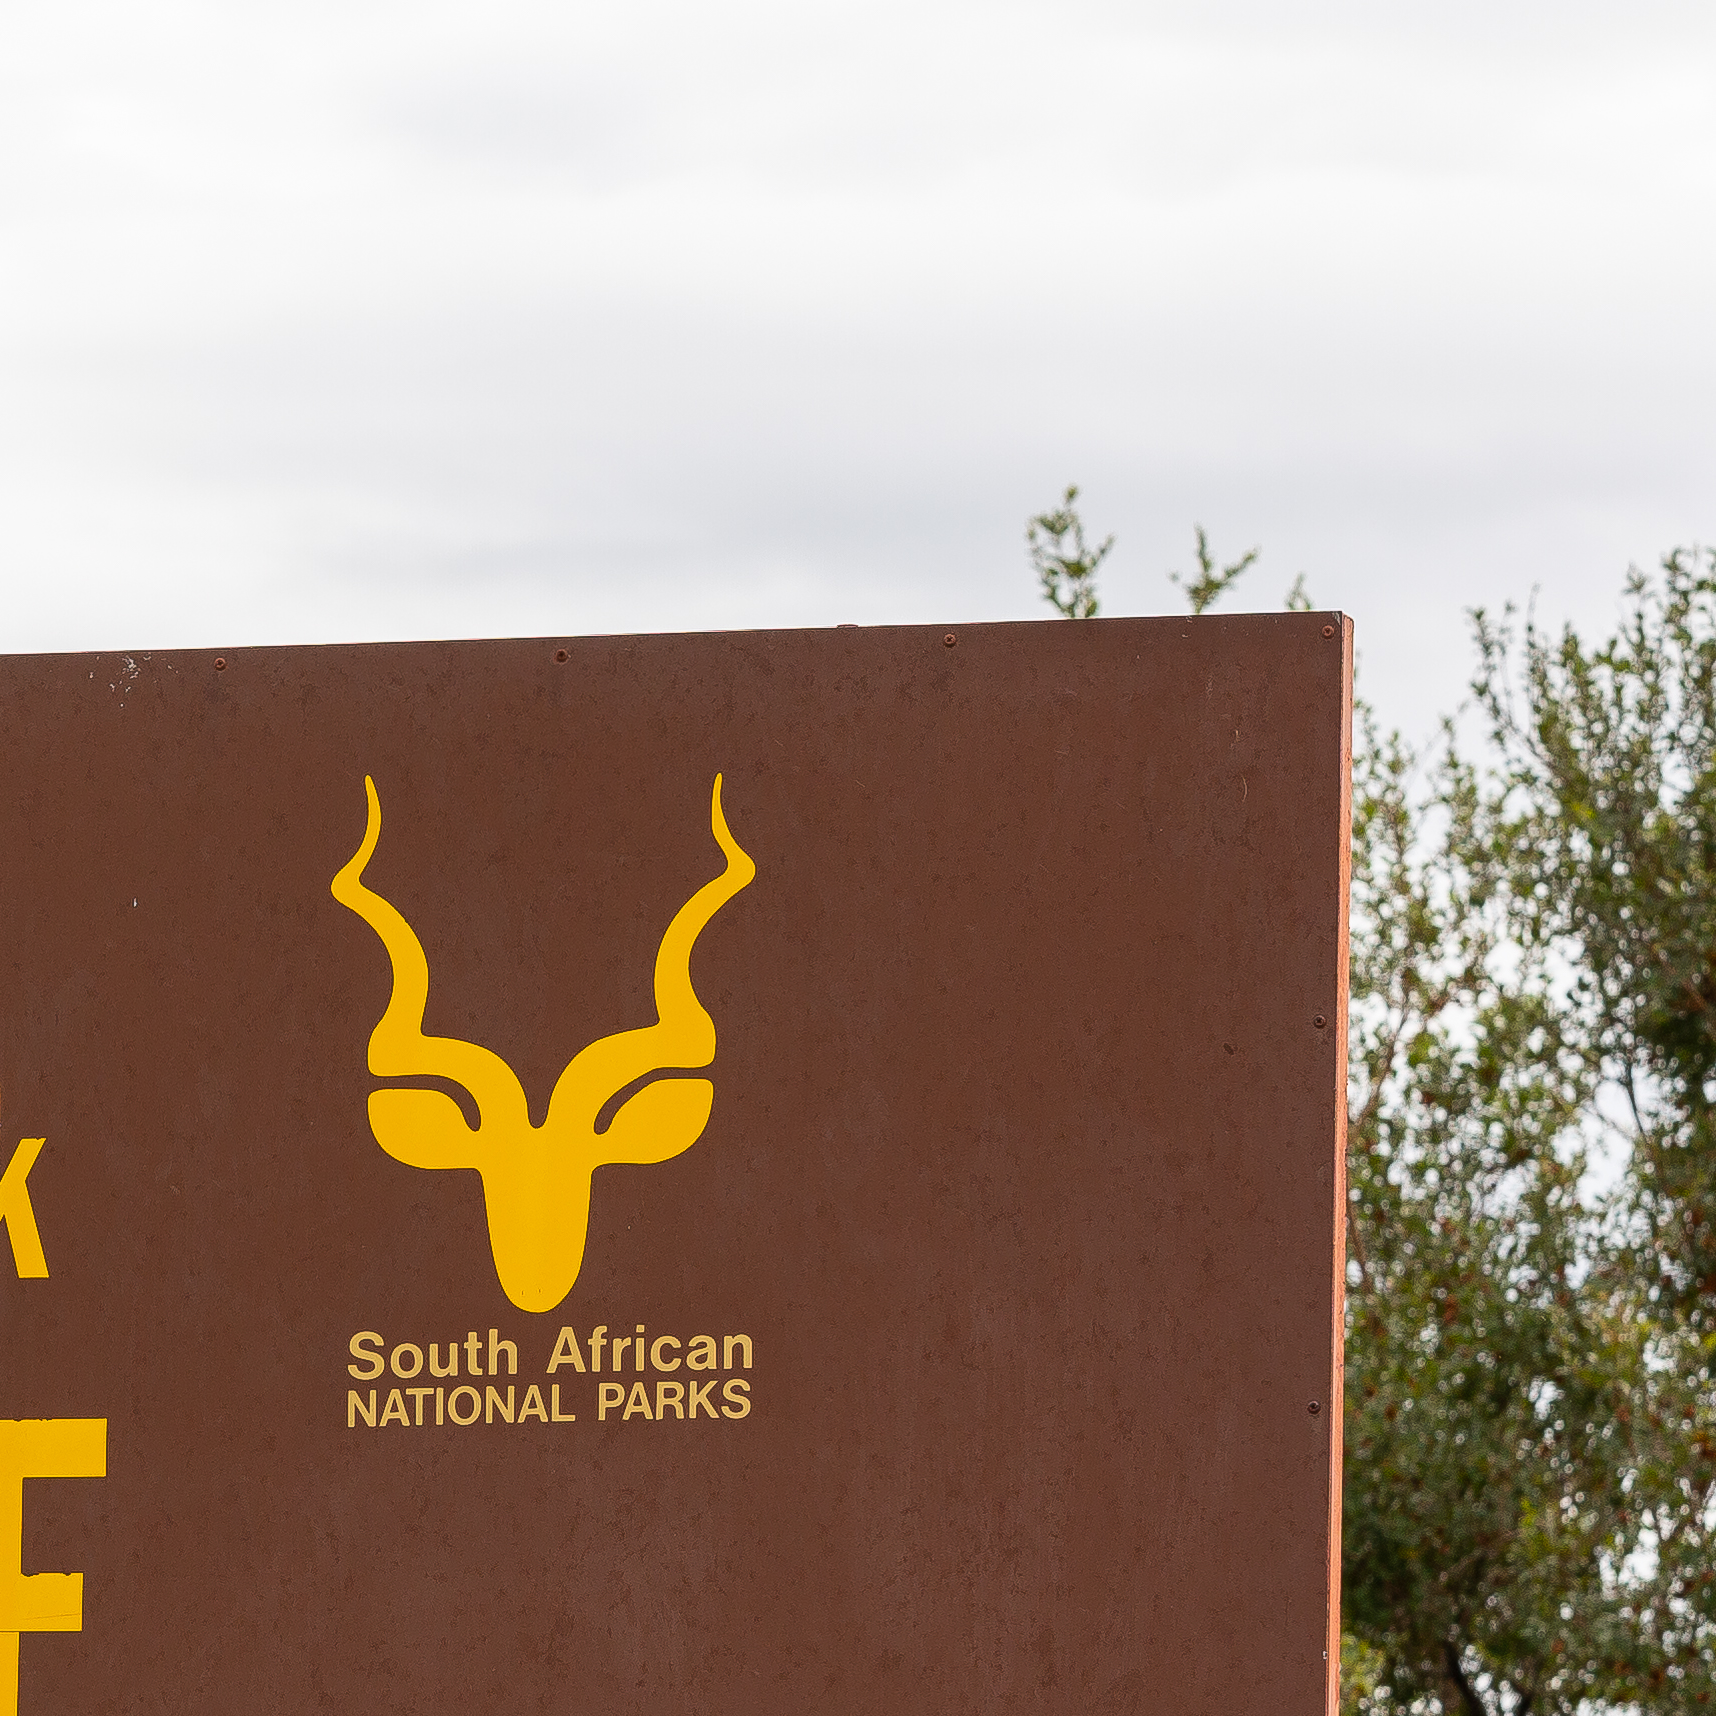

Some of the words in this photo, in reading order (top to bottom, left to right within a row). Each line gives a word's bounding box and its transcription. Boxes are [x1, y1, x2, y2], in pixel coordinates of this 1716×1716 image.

[347, 1328, 518, 1381] South
[545, 1324, 753, 1374] African
[347, 1383, 576, 1428] NATIONAL
[597, 1378, 752, 1421] PARKS
